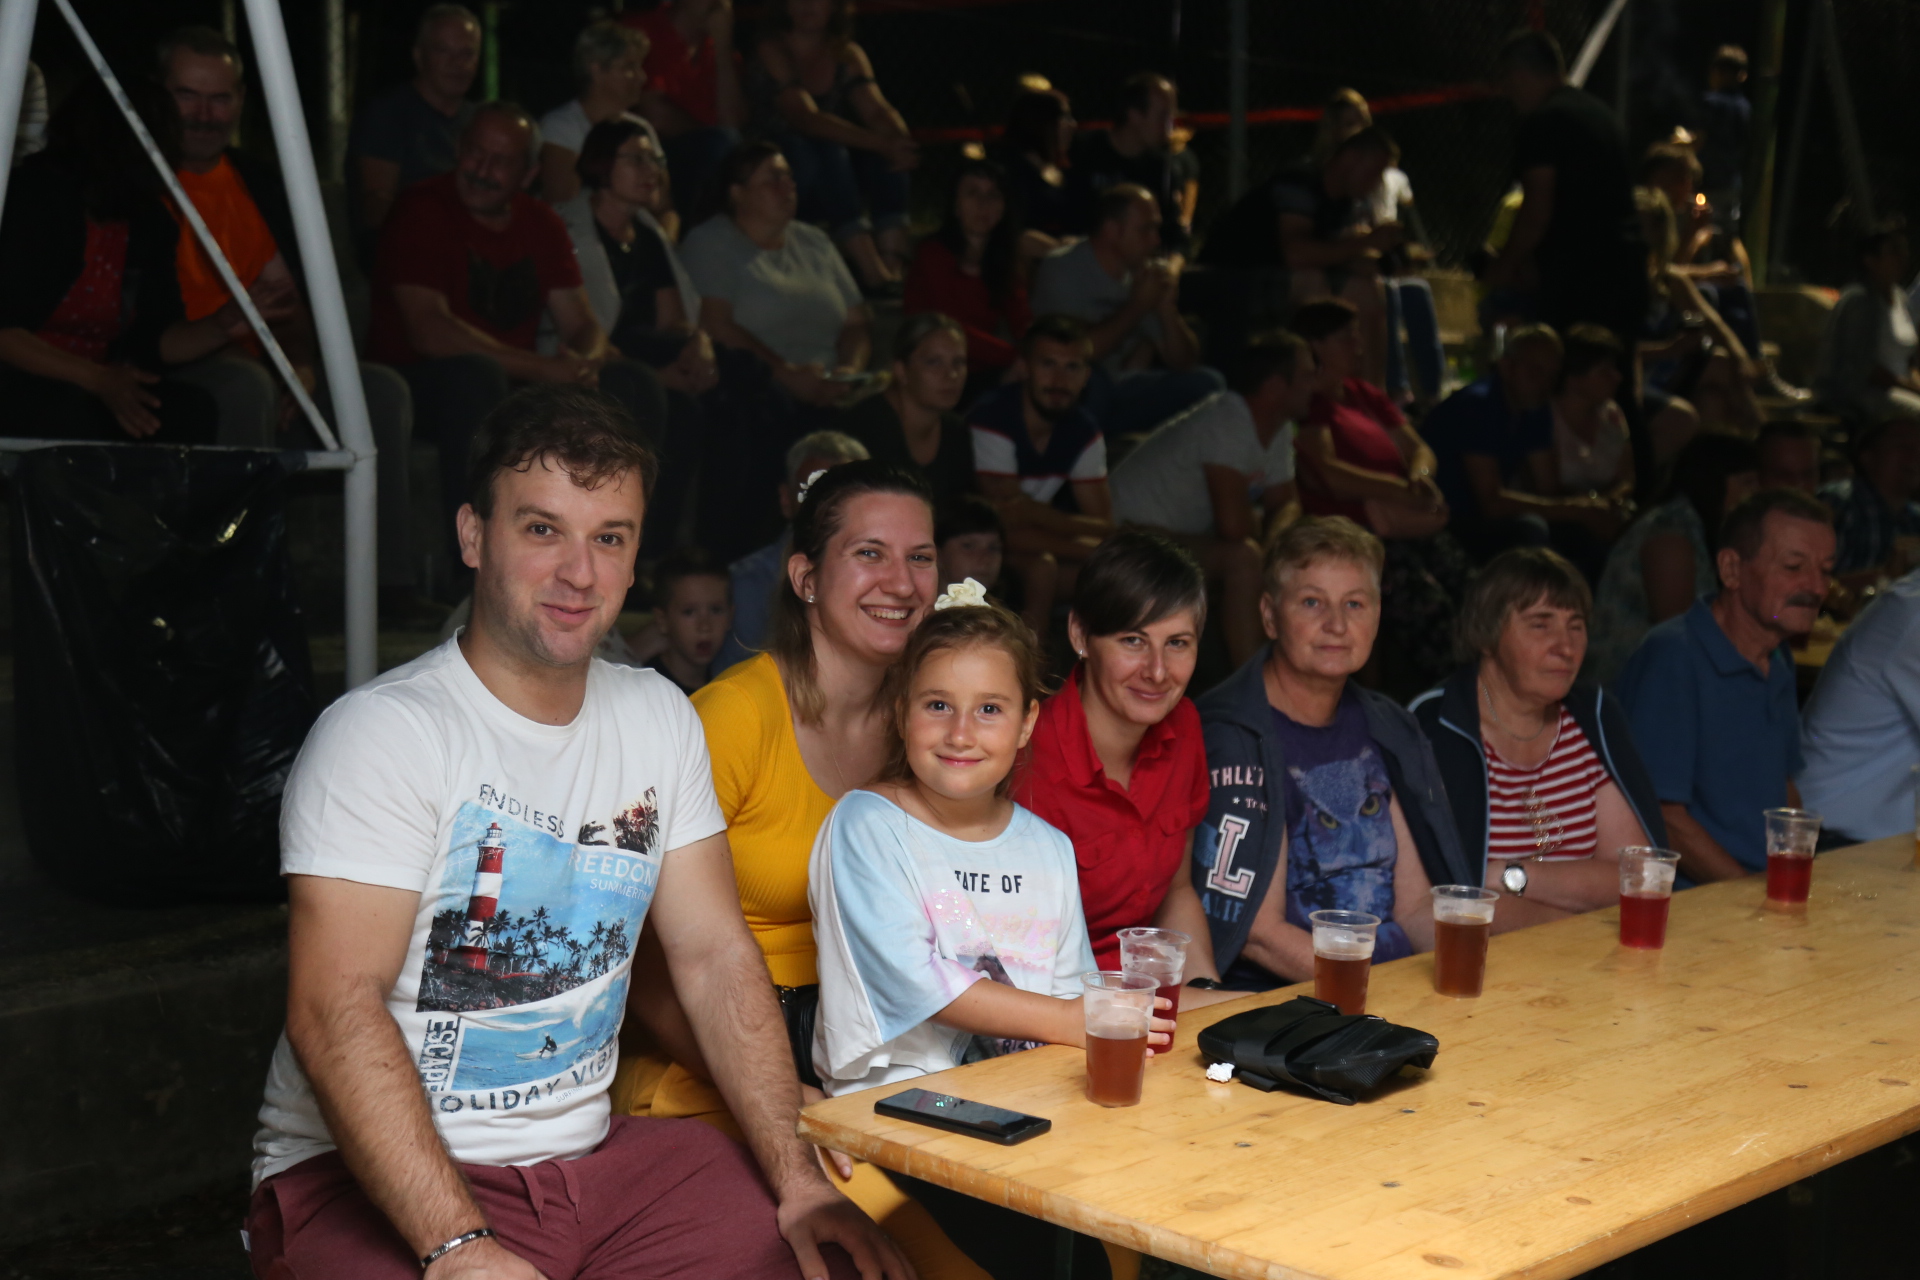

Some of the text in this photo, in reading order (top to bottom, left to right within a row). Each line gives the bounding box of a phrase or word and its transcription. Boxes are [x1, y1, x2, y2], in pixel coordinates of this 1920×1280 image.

[479, 783, 565, 838] ENDLESS
[1001, 874, 1023, 894] OF
[1206, 814, 1256, 899] L
